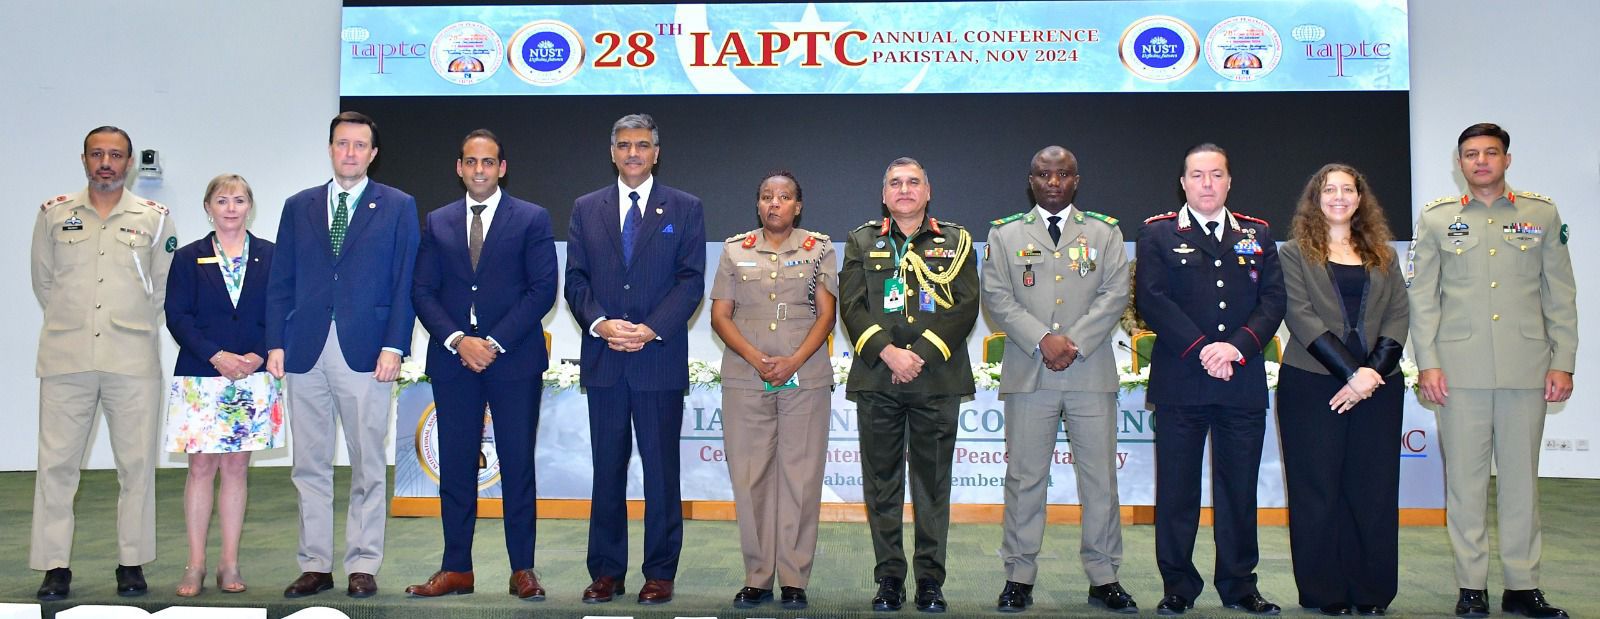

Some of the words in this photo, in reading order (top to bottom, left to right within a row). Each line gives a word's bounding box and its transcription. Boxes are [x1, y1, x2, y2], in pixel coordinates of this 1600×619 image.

[872, 31, 957, 44] ANNUAL
[964, 29, 1099, 43] CONFERENCE
[529, 48, 564, 58] NUST
[689, 30, 868, 67] IAPTC
[1142, 44, 1178, 54] NUST
[872, 50, 979, 64] PAKISTAN,
[986, 50, 1029, 63] NOV
[1035, 49, 1079, 62] 2024
